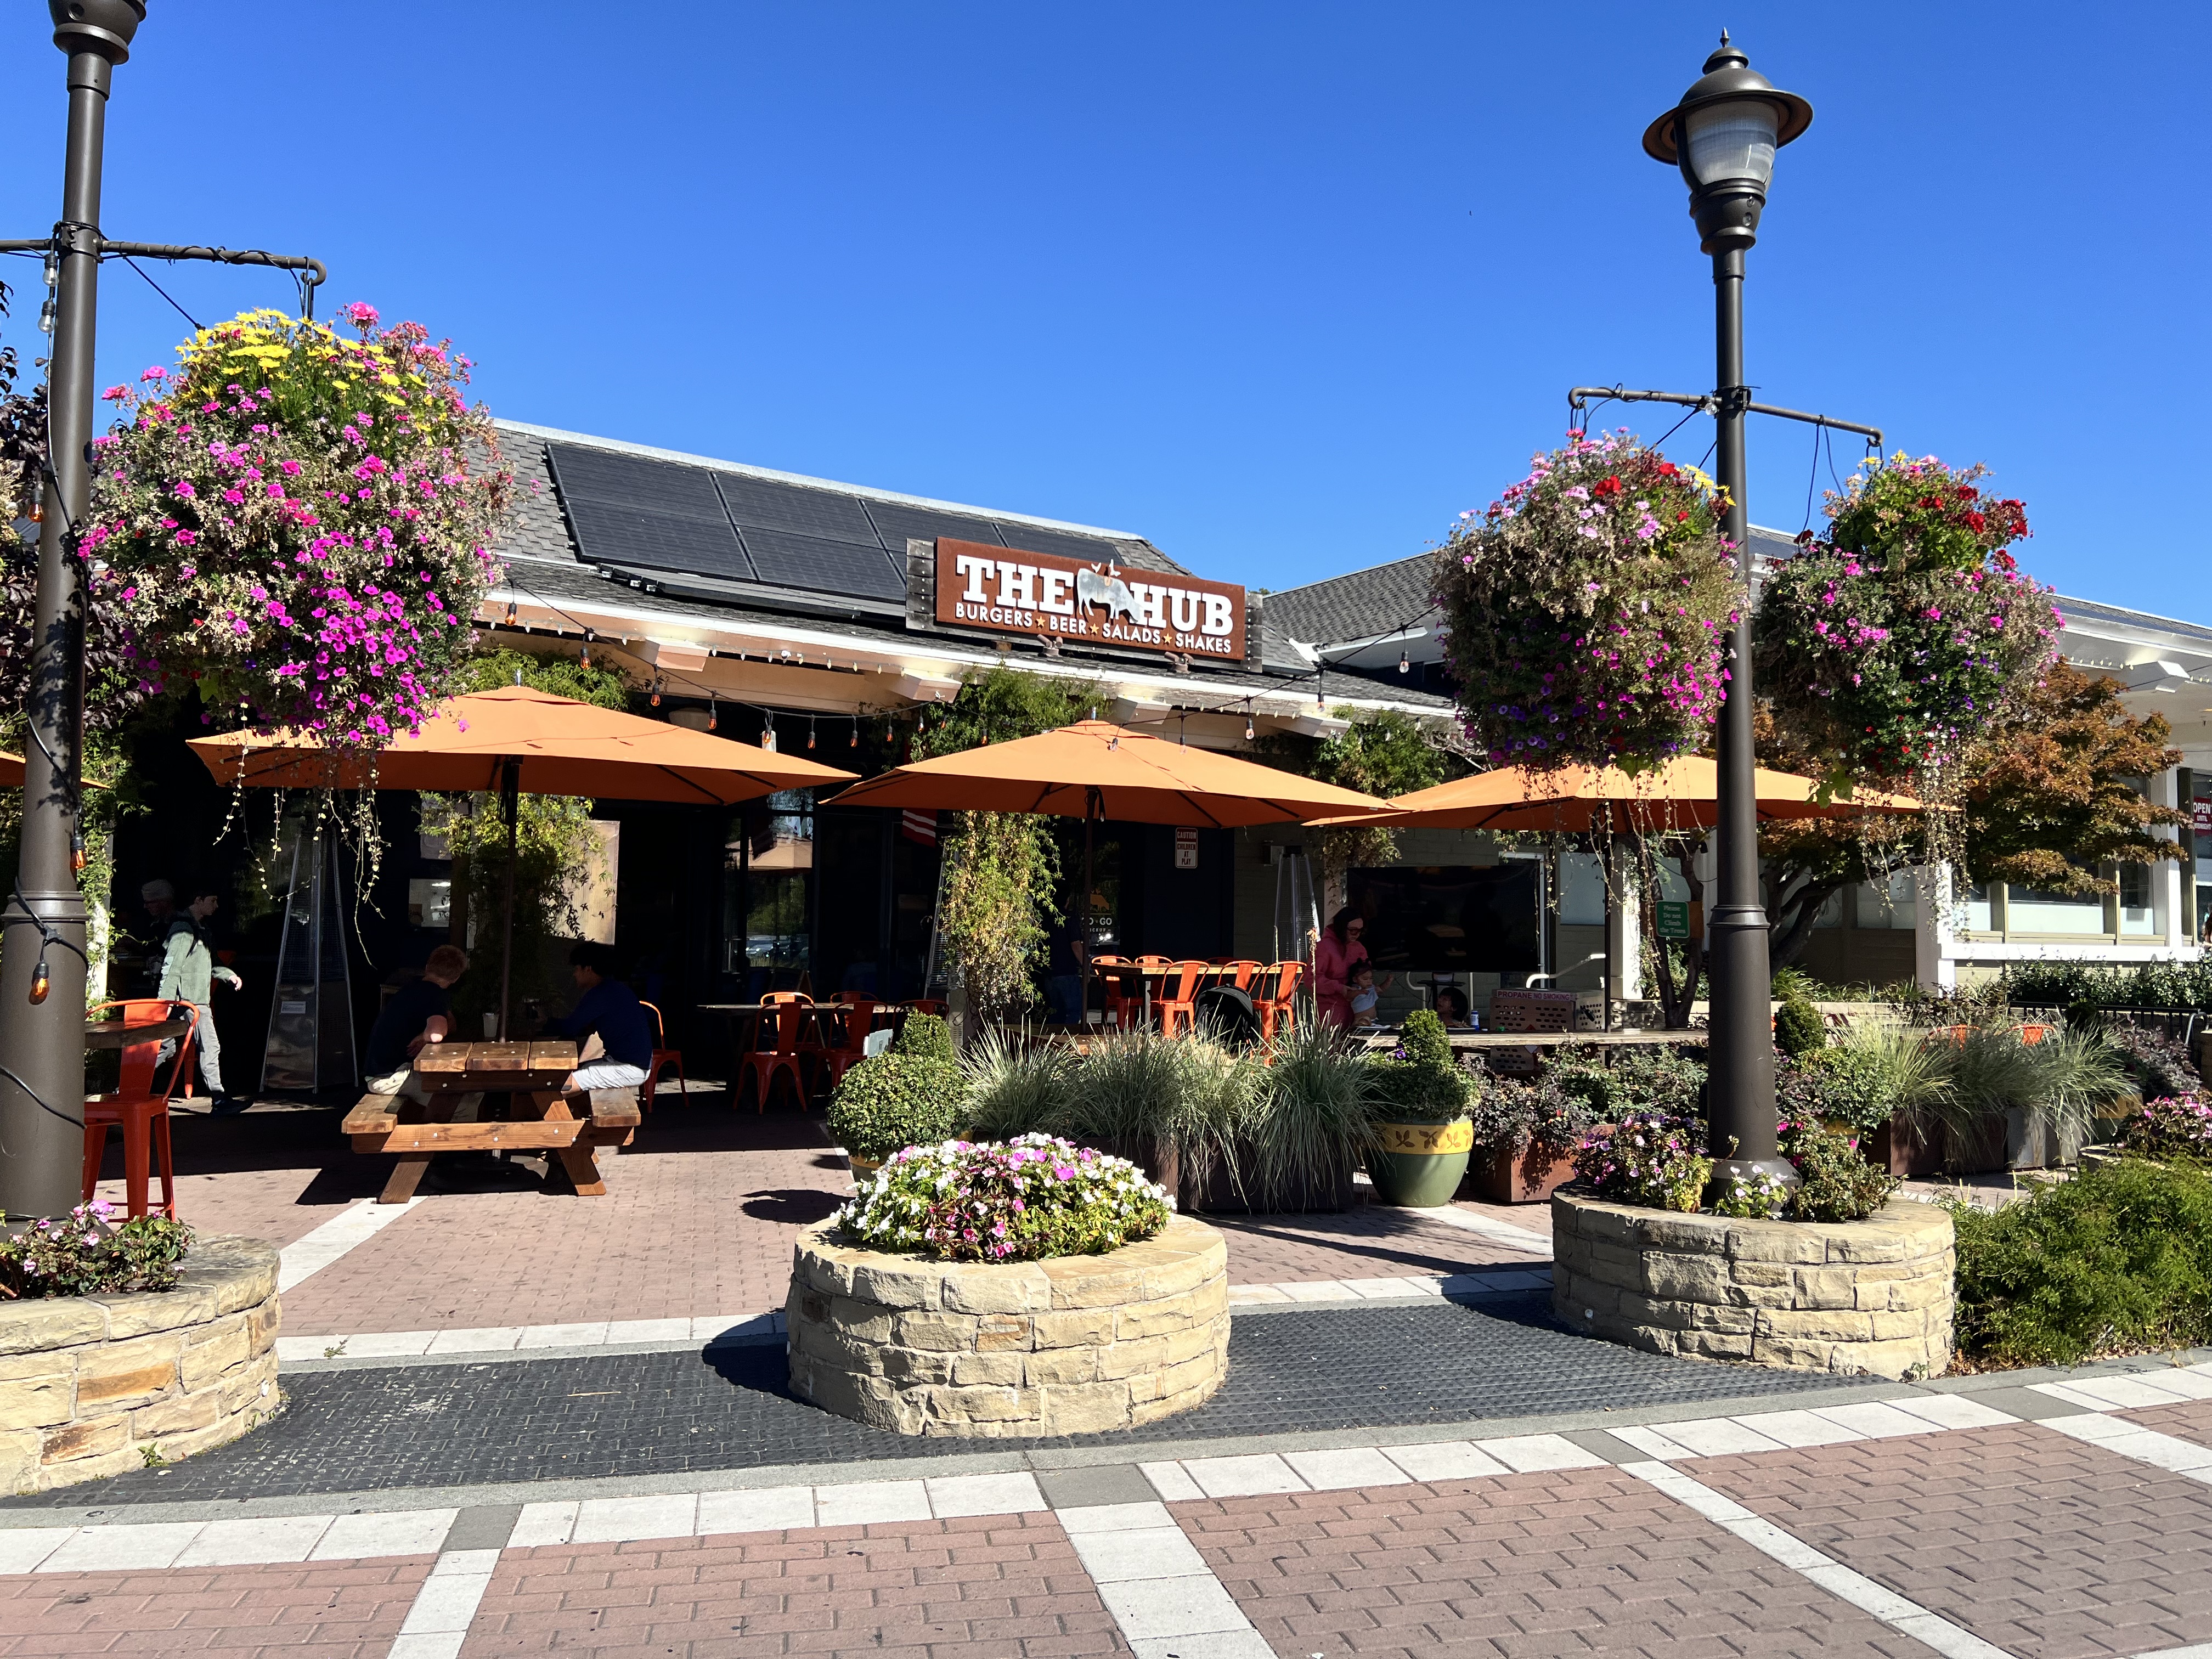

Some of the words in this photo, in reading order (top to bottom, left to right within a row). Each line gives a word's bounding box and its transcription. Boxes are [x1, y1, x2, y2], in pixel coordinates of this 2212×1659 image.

[957, 555, 1074, 615] THE
[1129, 582, 1233, 636] HUB
[956, 602, 1032, 627] BURGERS
[1049, 615, 1086, 634] BEER
[1102, 623, 1161, 644] SALADS
[1175, 633, 1231, 653] SHAKES
[2193, 803, 2210, 814] OPEN
[1498, 991, 1532, 999] PROPANE
